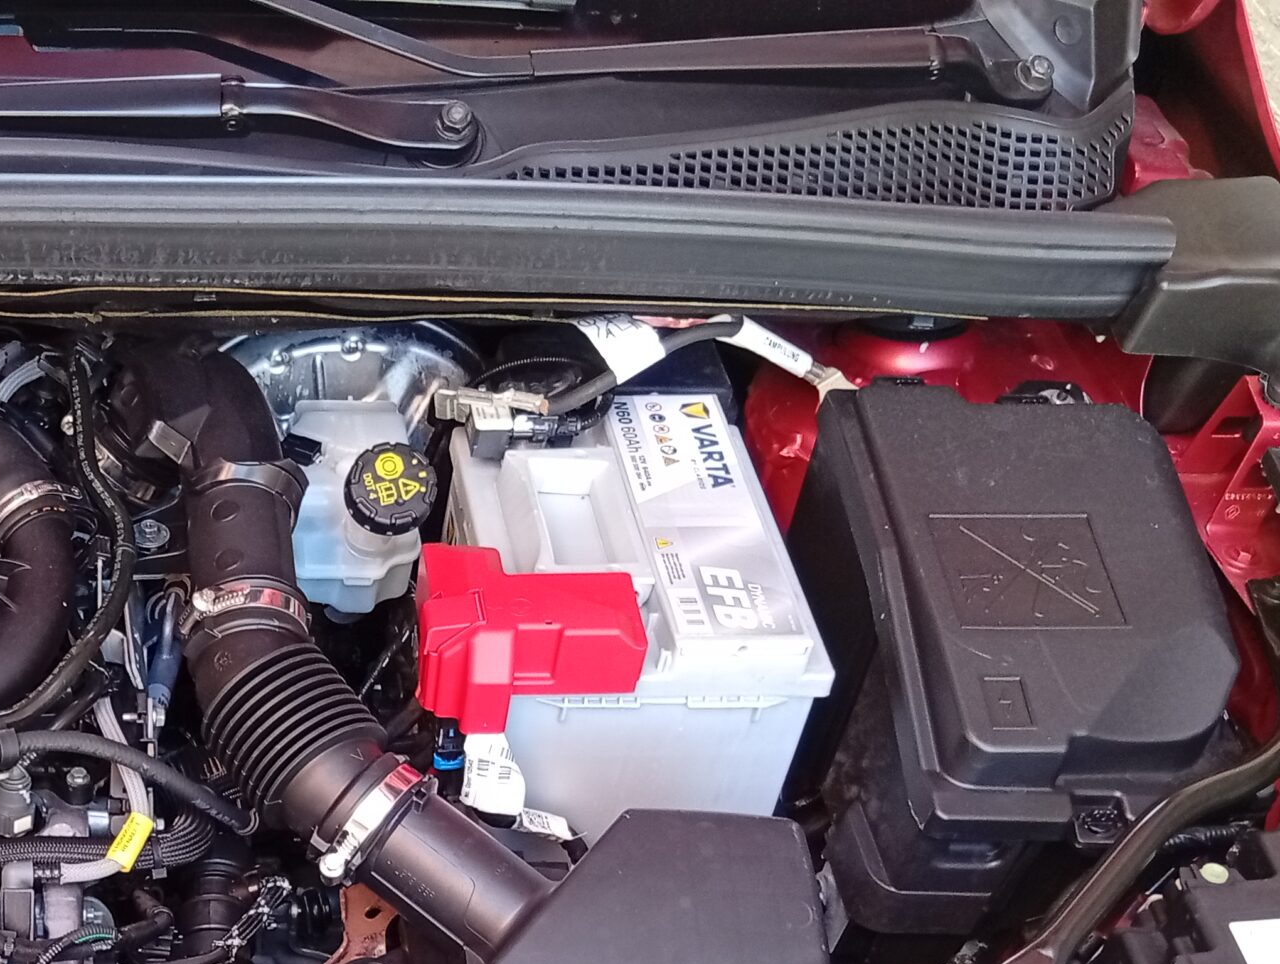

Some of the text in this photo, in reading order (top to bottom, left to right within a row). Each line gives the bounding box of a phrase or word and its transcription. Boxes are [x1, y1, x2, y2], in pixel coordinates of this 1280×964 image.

[613, 401, 632, 425] N60
[620, 426, 641, 455] 60Ah
[691, 424, 734, 489] VARTA
[363, 472, 378, 500] DOT 4
[699, 566, 758, 631] EFB
[747, 583, 776, 629] DYNAMIC
